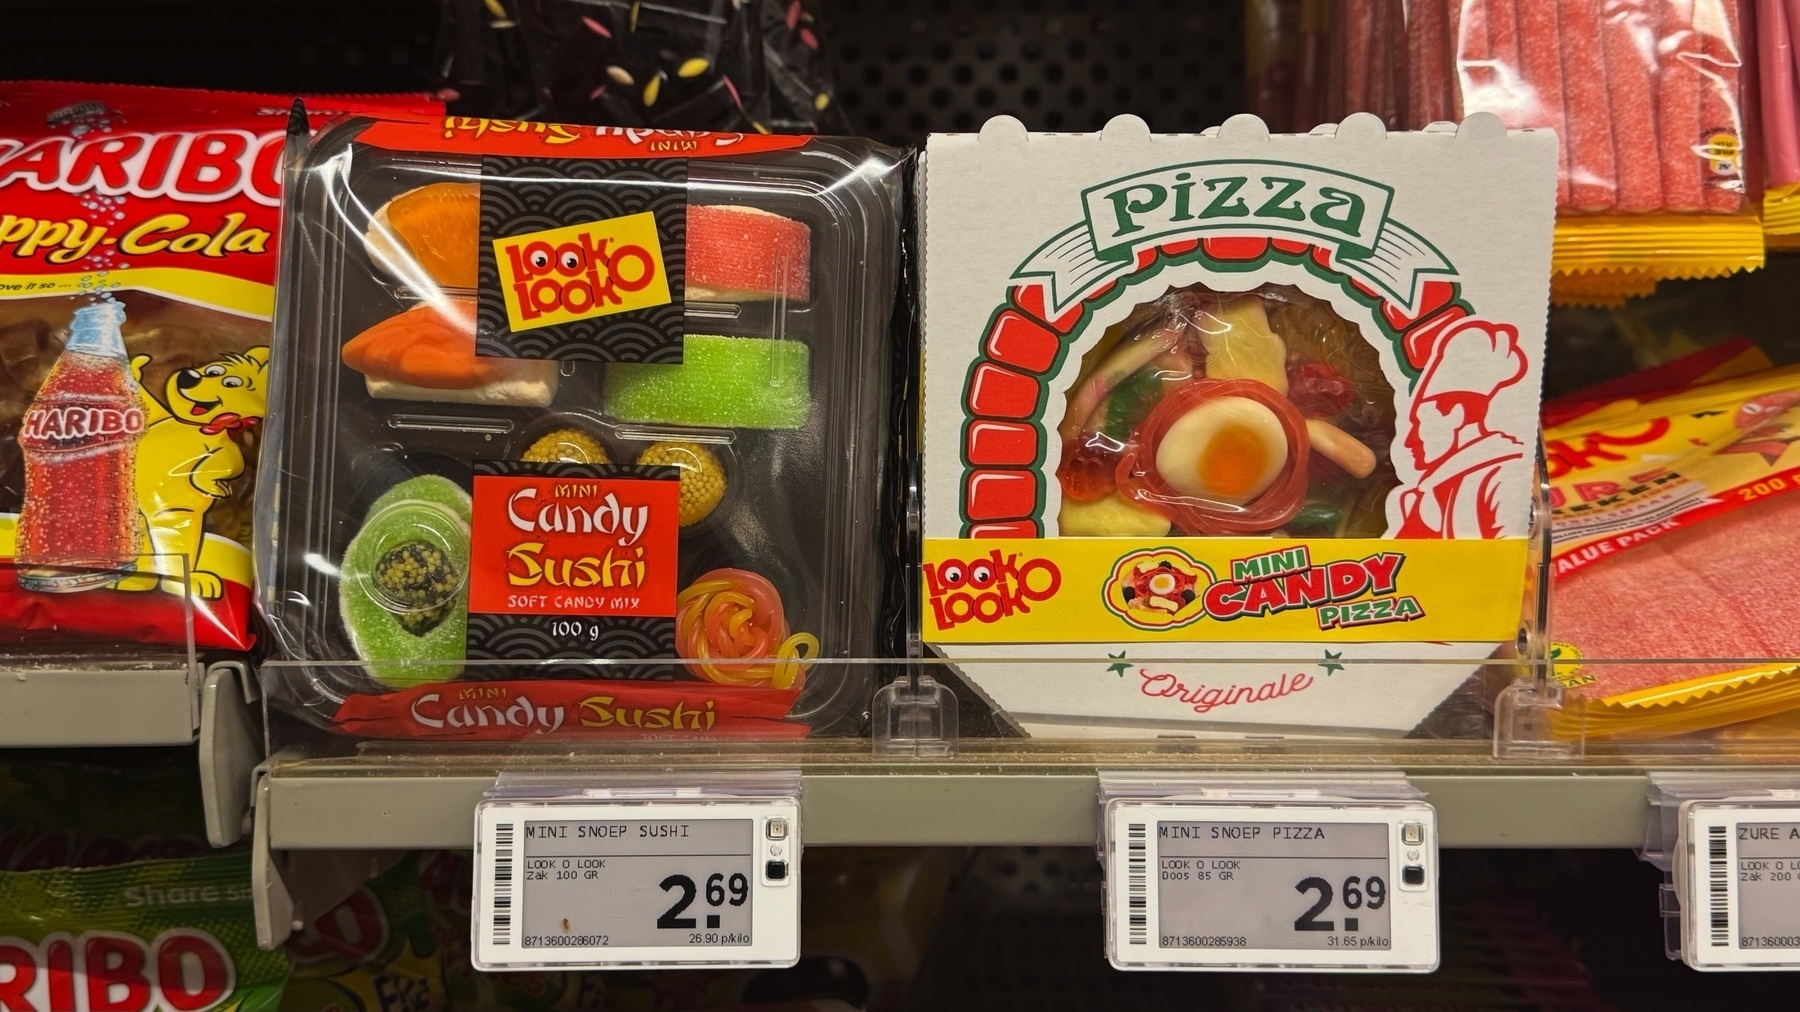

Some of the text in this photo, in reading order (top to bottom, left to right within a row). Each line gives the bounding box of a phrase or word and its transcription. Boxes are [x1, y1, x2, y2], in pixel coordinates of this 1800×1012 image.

[650, 140, 697, 151] MINI
[0, 212, 271, 263] ppy-Cola
[26, 282, 37, 290] it
[23, 407, 146, 440] HARIBO
[555, 484, 598, 498] MINI
[1738, 478, 1786, 501] 200
[508, 488, 648, 546] Candy
[1554, 541, 1615, 575] ALUE
[1616, 518, 1680, 548] PACK
[506, 542, 646, 588] Sushi
[1233, 548, 1308, 582] MINI
[1203, 553, 1405, 618] CANDY
[508, 594, 640, 609] SOFT CANDY MIX
[1319, 597, 1421, 627] PIZZA
[552, 621, 599, 641] 100 g
[459, 688, 507, 700] MINI
[1140, 668, 1314, 714] Originale
[411, 693, 716, 735] Candy Sushi
[526, 825, 689, 838] MINI SNOEP SUSHI
[1159, 827, 1325, 840] MINI SNOEP PIZZA
[1738, 827, 1800, 840] ZURE A
[527, 860, 556, 869] LOOK
[577, 860, 606, 869] LOOK
[1162, 860, 1190, 870] LOOK
[1212, 861, 1241, 870] LOOK
[1741, 861, 1769, 870] LOOK
[526, 871, 599, 880] Zak 100 GR
[1162, 871, 1234, 881] Doos 85 GR
[1740, 872, 1762, 881] Zak
[1770, 872, 1791, 881] 200
[124, 884, 220, 907] Share
[525, 935, 608, 946] 8713600286072
[689, 933, 750, 946] 26.90 p/kilo
[1162, 936, 1246, 947] 8713600285938
[1327, 936, 1388, 948] 31.65 p/kilo
[1741, 936, 1800, 947] 871360003
[0, 931, 233, 1012] RIBO
